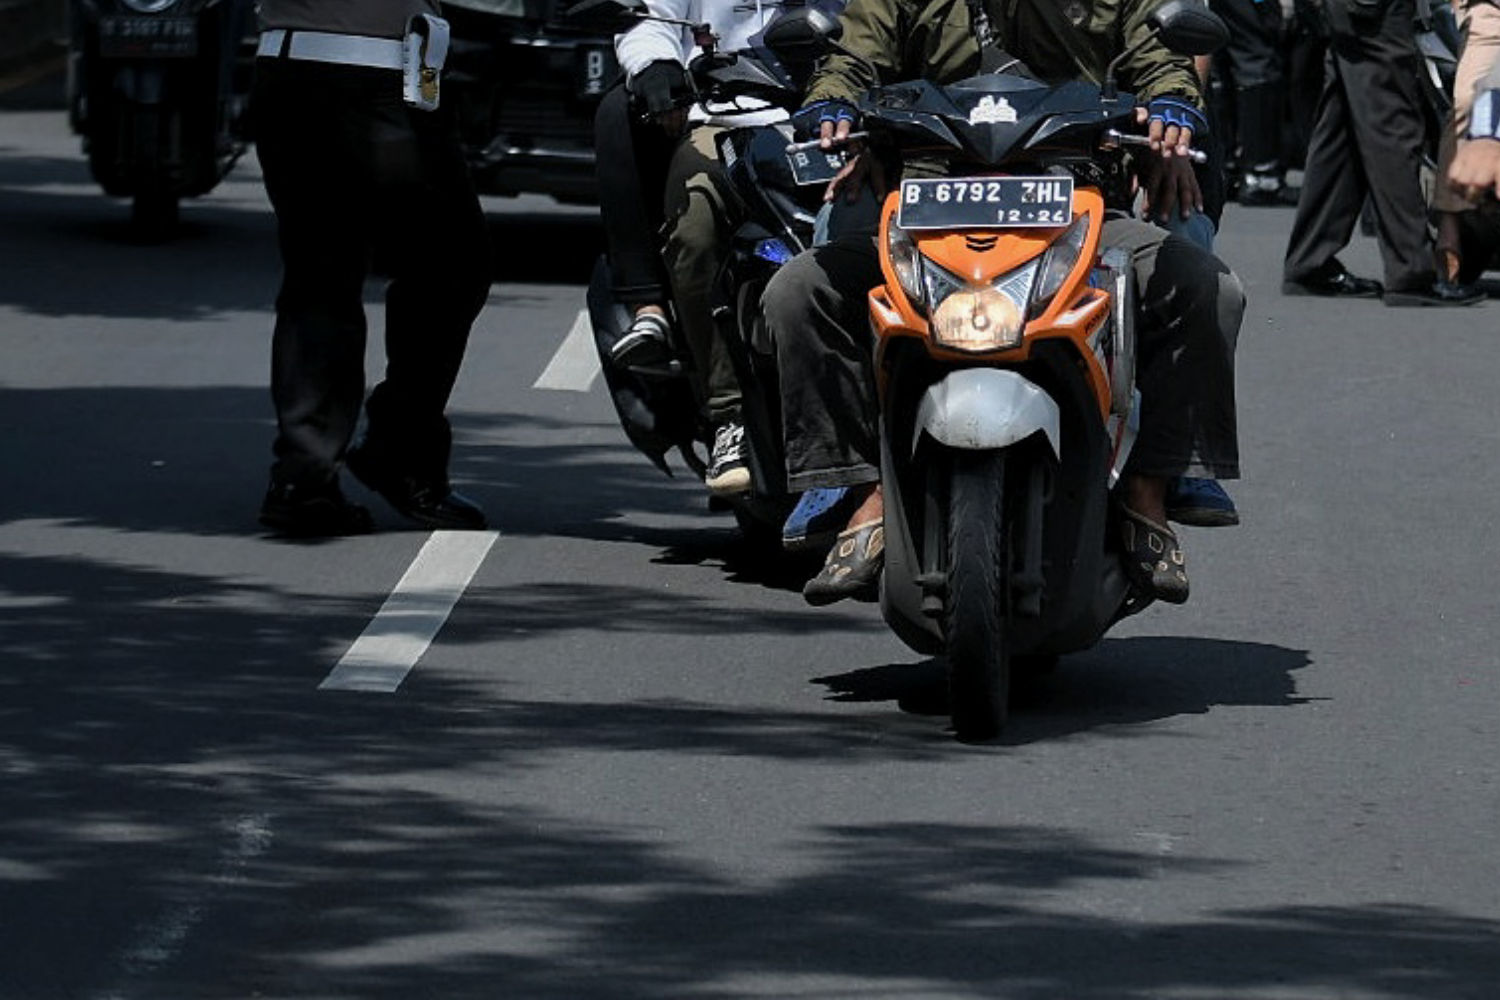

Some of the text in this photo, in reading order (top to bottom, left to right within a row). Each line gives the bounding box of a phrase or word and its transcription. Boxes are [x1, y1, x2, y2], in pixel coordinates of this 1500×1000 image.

[905, 181, 1068, 204] B 6792 ZHL
